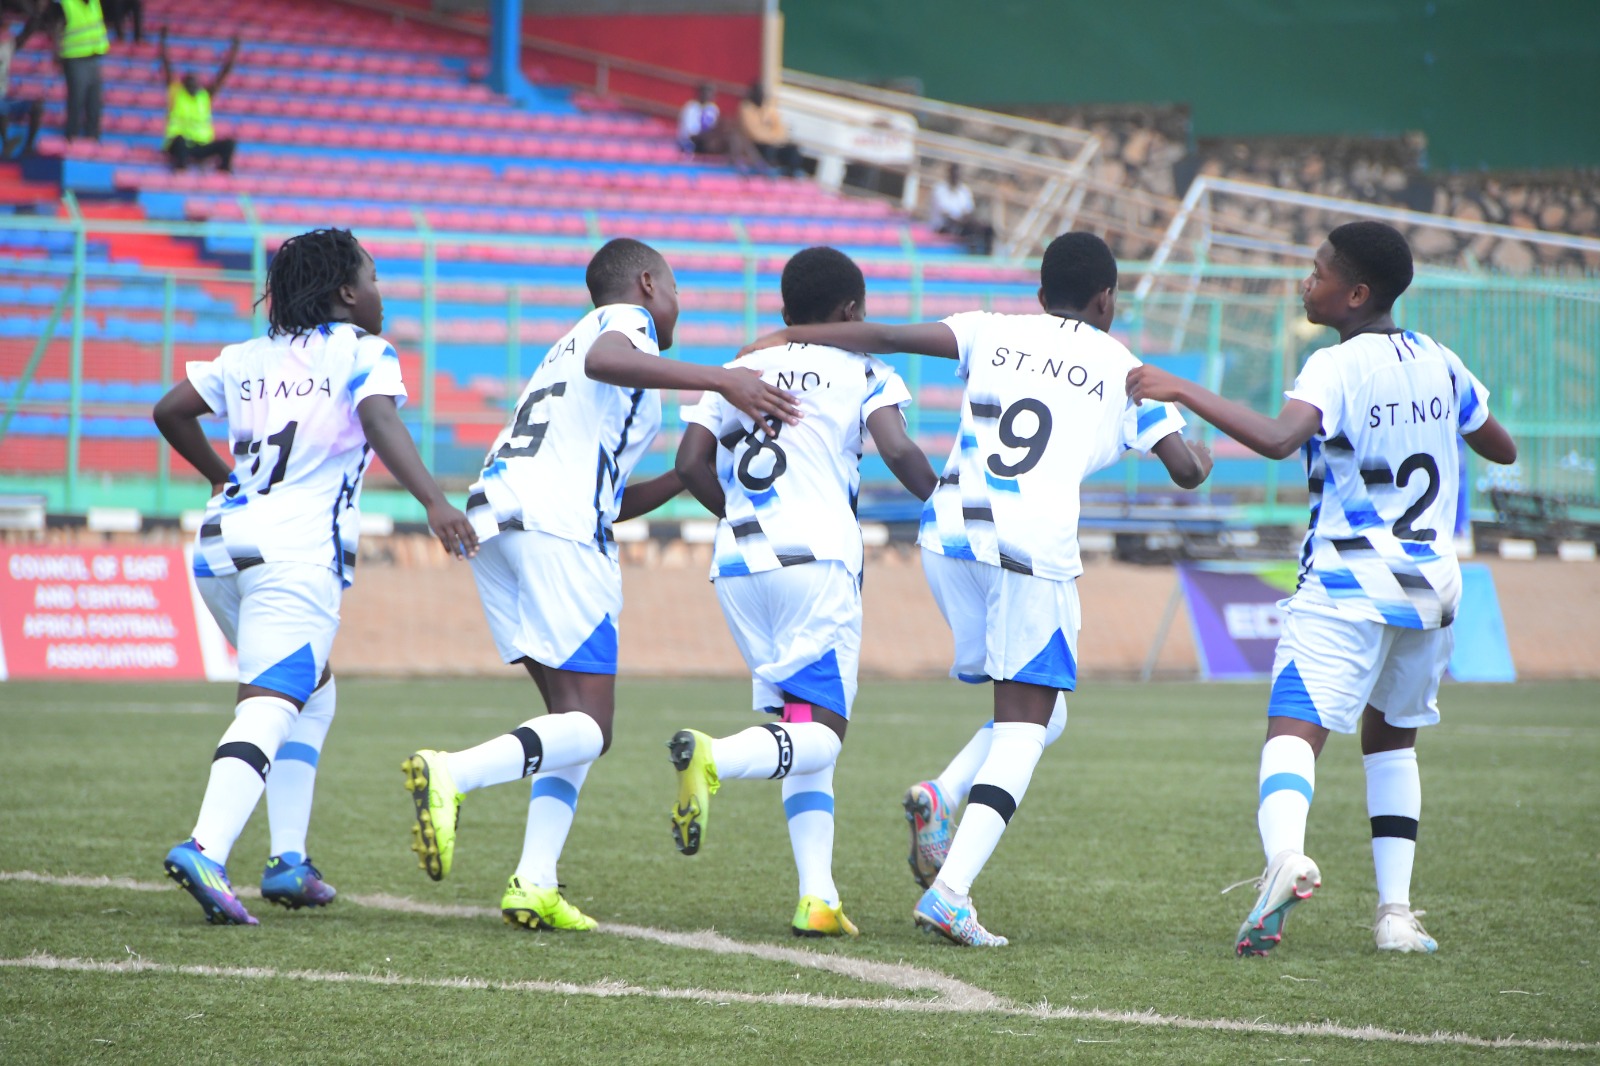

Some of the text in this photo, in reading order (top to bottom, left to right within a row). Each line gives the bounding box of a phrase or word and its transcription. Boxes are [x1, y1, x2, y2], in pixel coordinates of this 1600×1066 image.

[777, 371, 831, 392] NO
[992, 347, 1104, 402] ST.NOA
[987, 398, 1053, 478] 9
[737, 415, 787, 491] 8
[1392, 453, 1440, 542] 2
[9, 554, 170, 581] COUNCIL OF EAST
[34, 584, 160, 610] AND CENTRAL
[23, 614, 178, 639] AFRICA FOOTBALL
[46, 643, 178, 669] ASSOCIATIONS
